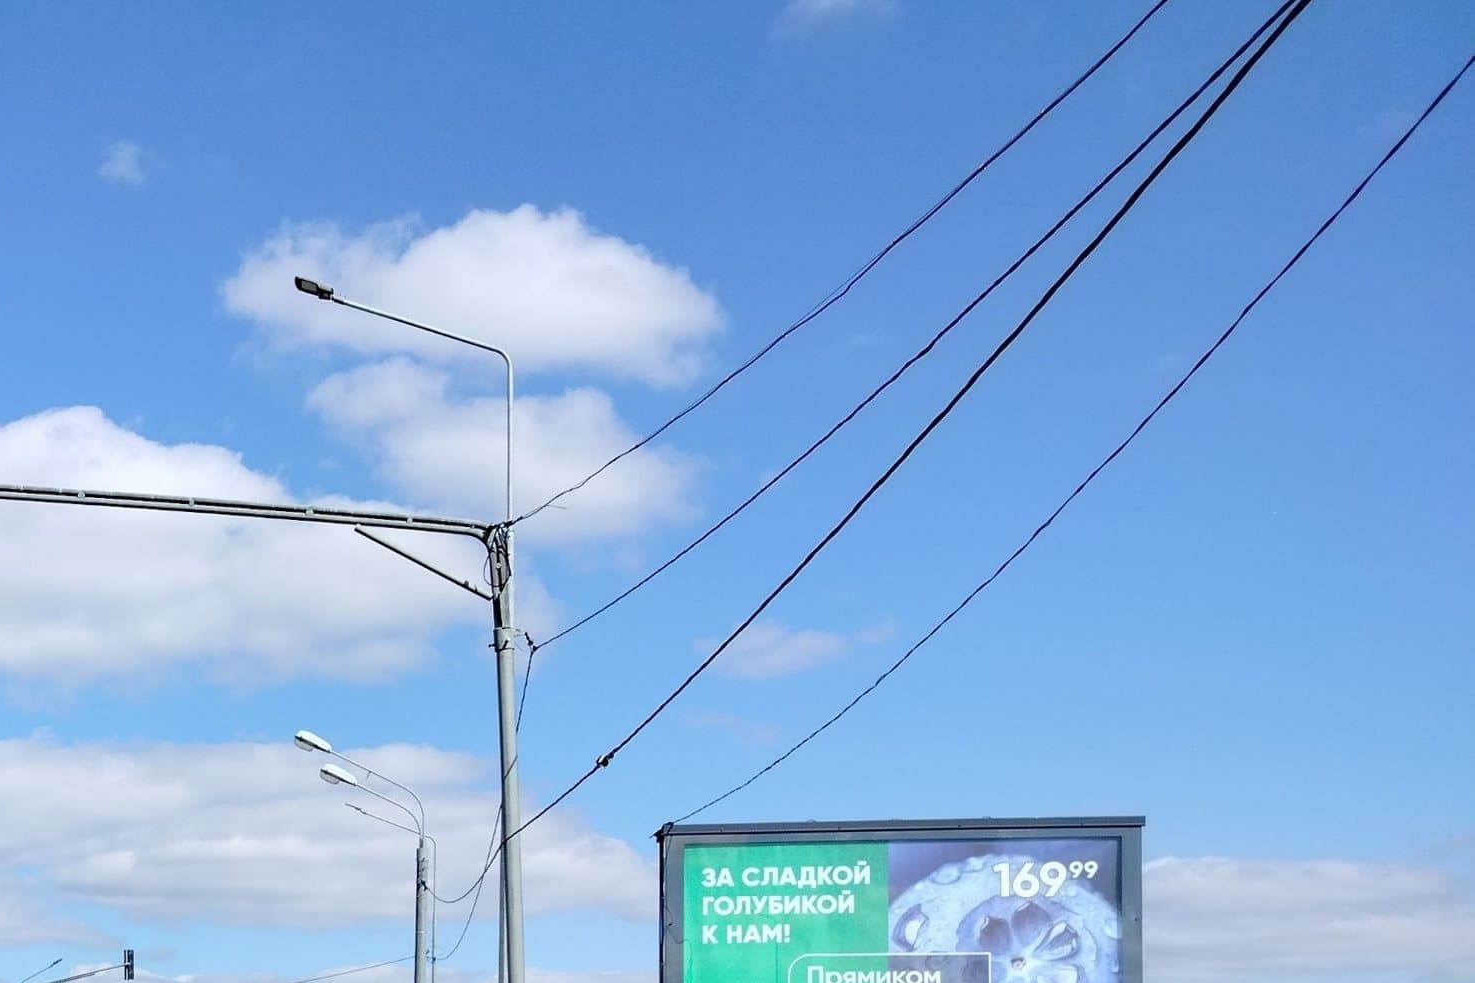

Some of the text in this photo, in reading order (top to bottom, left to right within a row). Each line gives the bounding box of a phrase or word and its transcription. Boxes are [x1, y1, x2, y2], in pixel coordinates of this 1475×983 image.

[701, 860, 871, 888] ЗА СЛАДКОЙ
[702, 890, 855, 916] ГОЛУБИКОЙ
[702, 924, 791, 944] К НАМ!
